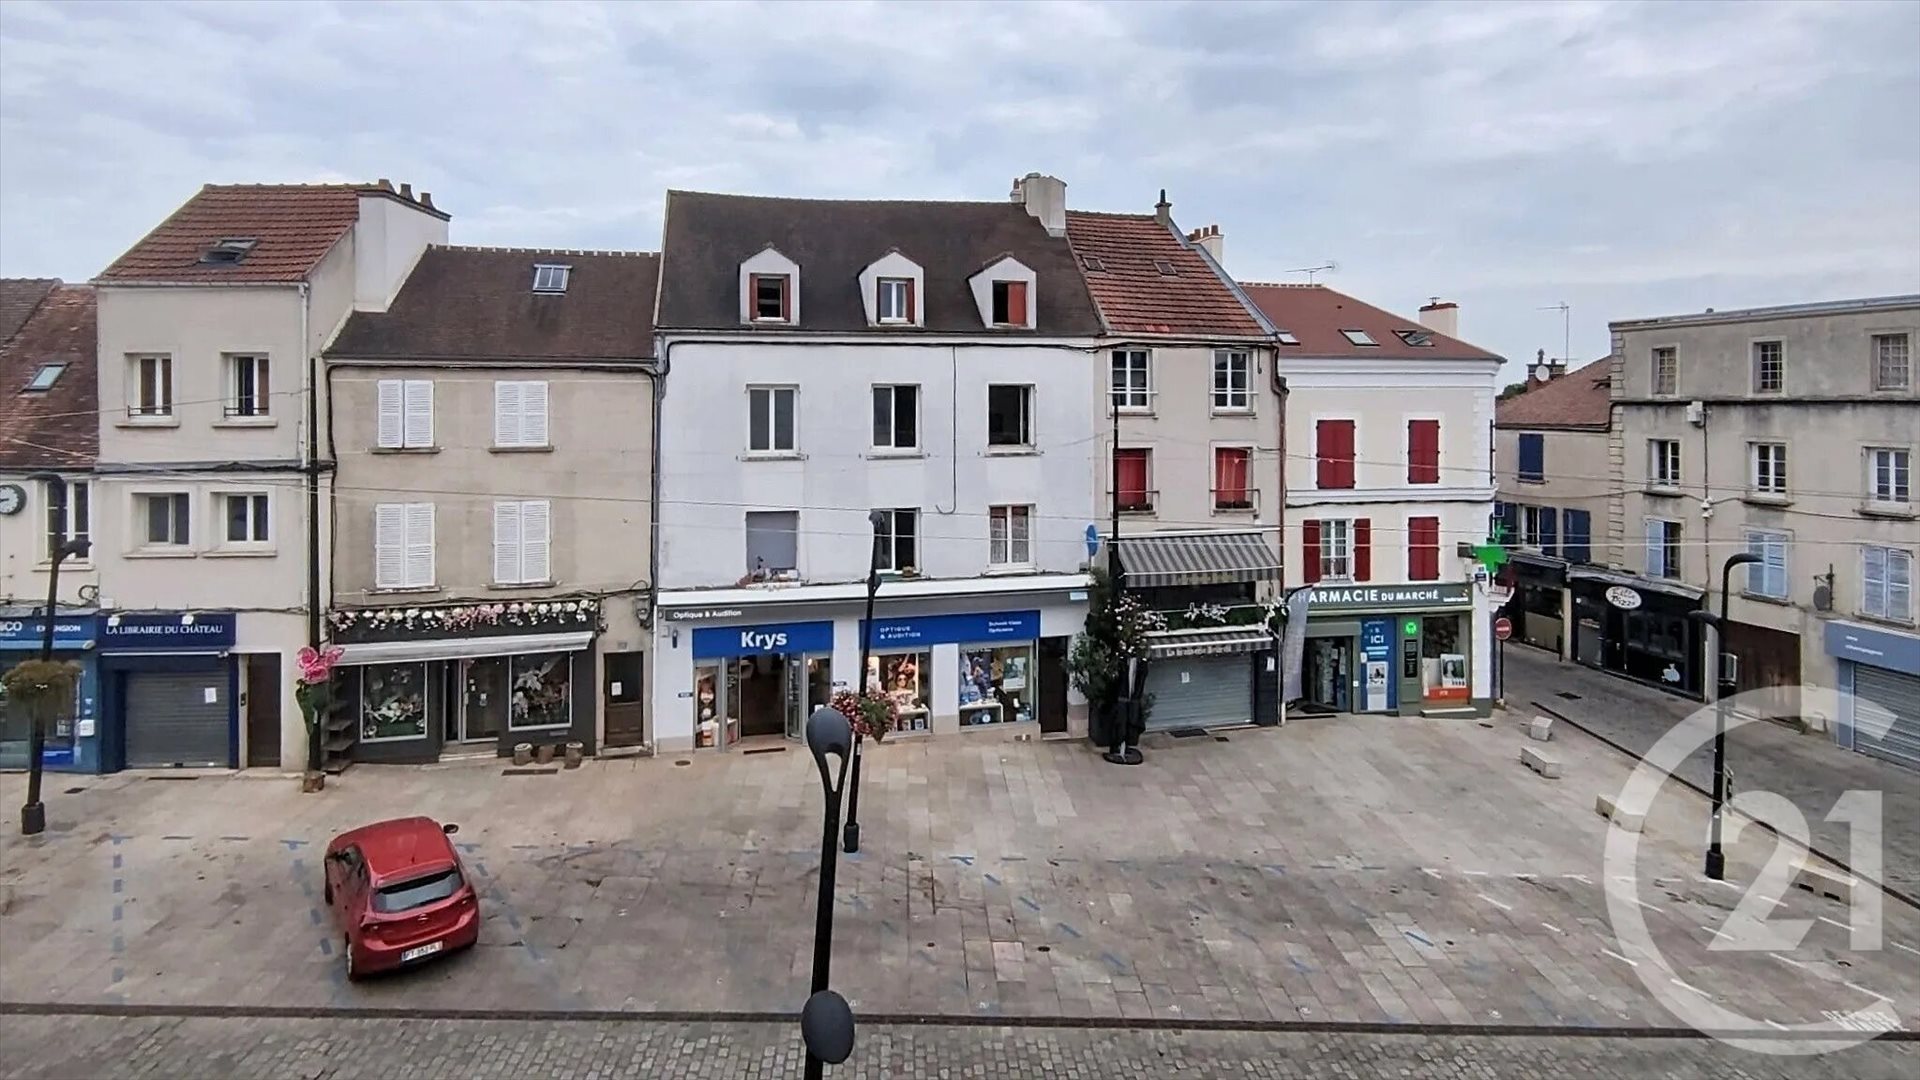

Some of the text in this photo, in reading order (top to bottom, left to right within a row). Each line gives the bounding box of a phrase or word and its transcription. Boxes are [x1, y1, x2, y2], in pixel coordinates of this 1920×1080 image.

[1296, 590, 1379, 604] HARMACIE
[1381, 593, 1394, 601] DU
[1396, 589, 1439, 601] MARCHÉ
[673, 611, 703, 619] Optique
[712, 610, 742, 618] Audition
[106, 624, 223, 635] LA LIBRAIRIE DU CHÂTEAU
[741, 631, 788, 650] Krys
[1370, 634, 1385, 644] ICI
